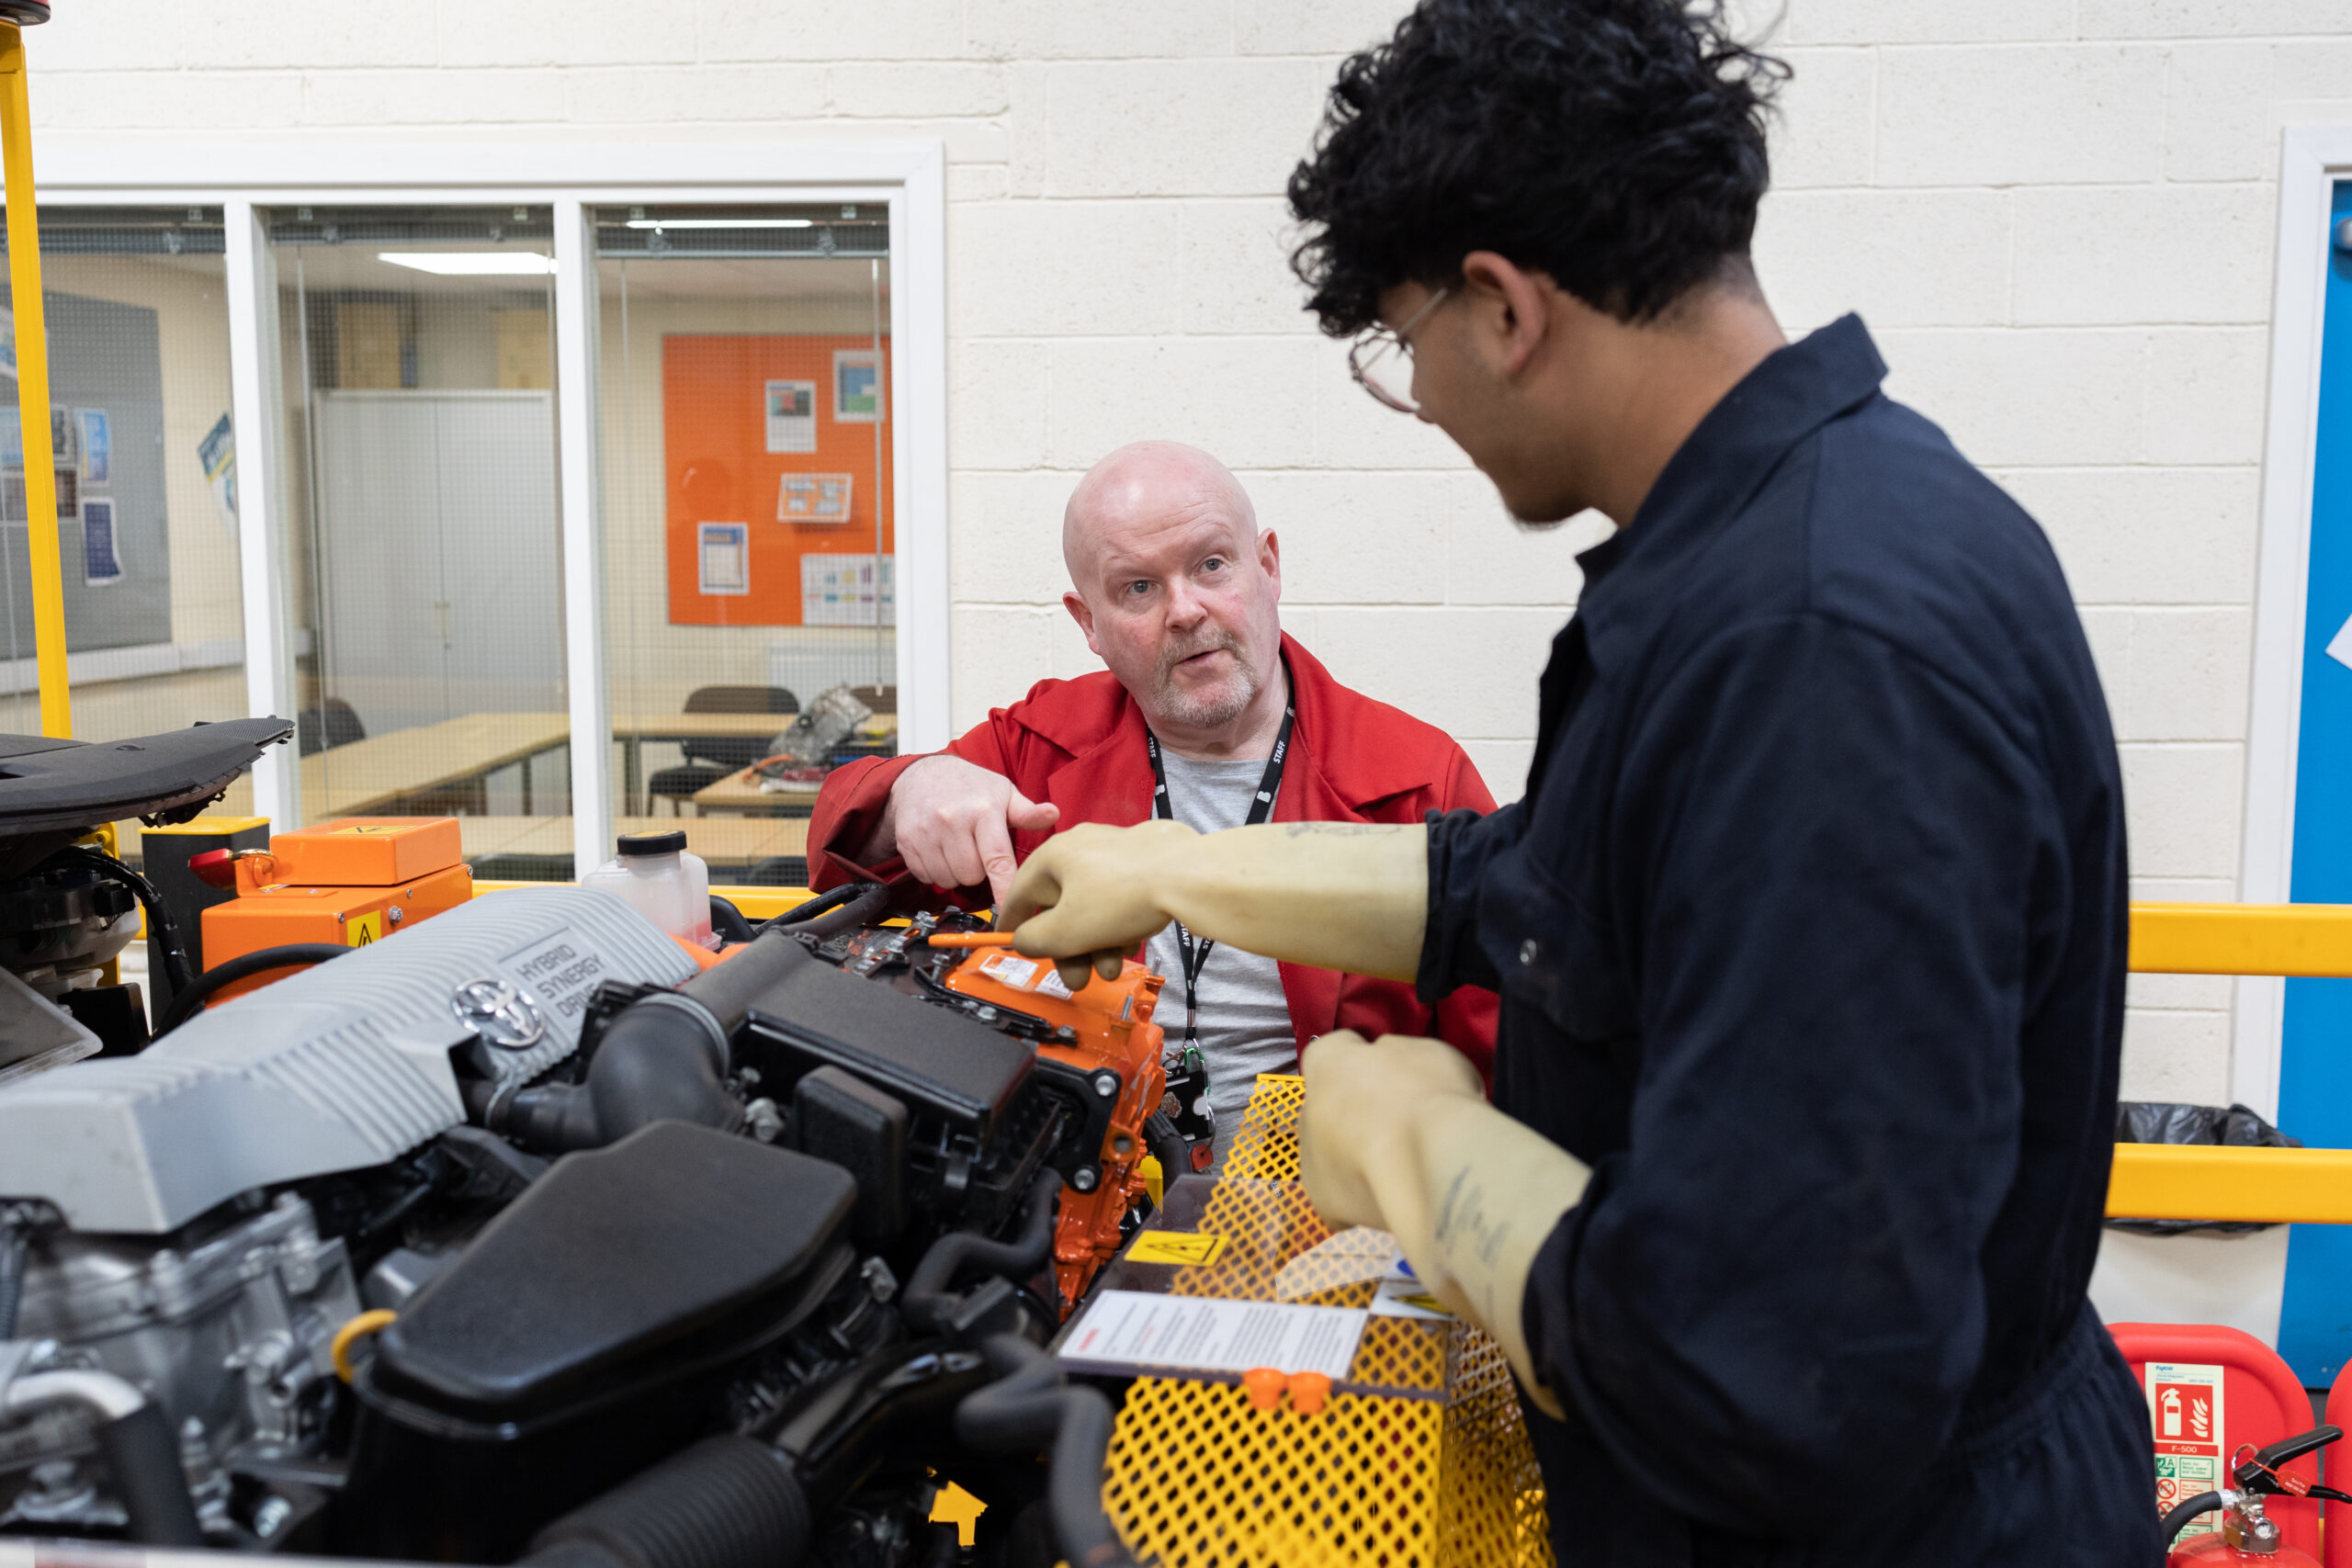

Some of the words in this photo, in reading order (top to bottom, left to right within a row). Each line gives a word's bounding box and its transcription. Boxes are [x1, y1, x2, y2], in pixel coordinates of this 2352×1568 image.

[1148, 737, 1157, 758] STAFF
[1272, 739, 1285, 763] STAFF
[515, 943, 576, 982] HYBRID
[536, 953, 605, 999] SYNERGY
[2171, 1445, 2198, 1454] F-500
[2167, 1458, 2174, 1466] A
